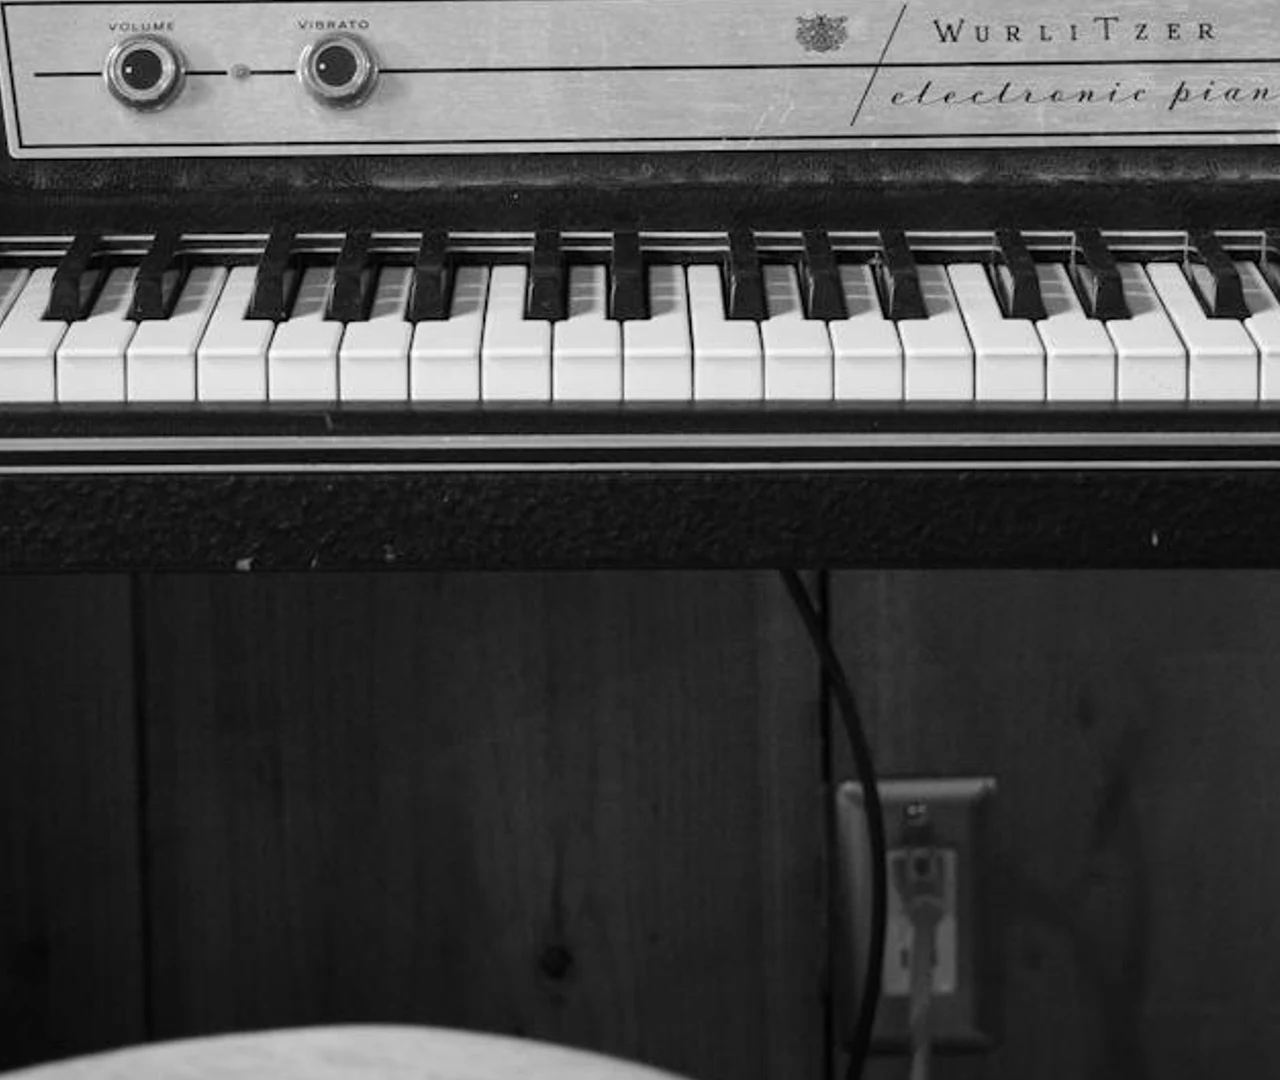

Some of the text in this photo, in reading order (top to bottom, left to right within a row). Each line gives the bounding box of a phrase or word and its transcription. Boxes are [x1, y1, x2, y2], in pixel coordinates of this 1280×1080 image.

[108, 21, 175, 33] VOLUME
[297, 19, 370, 30] VIBRATO
[890, 80, 1146, 106] electronic
